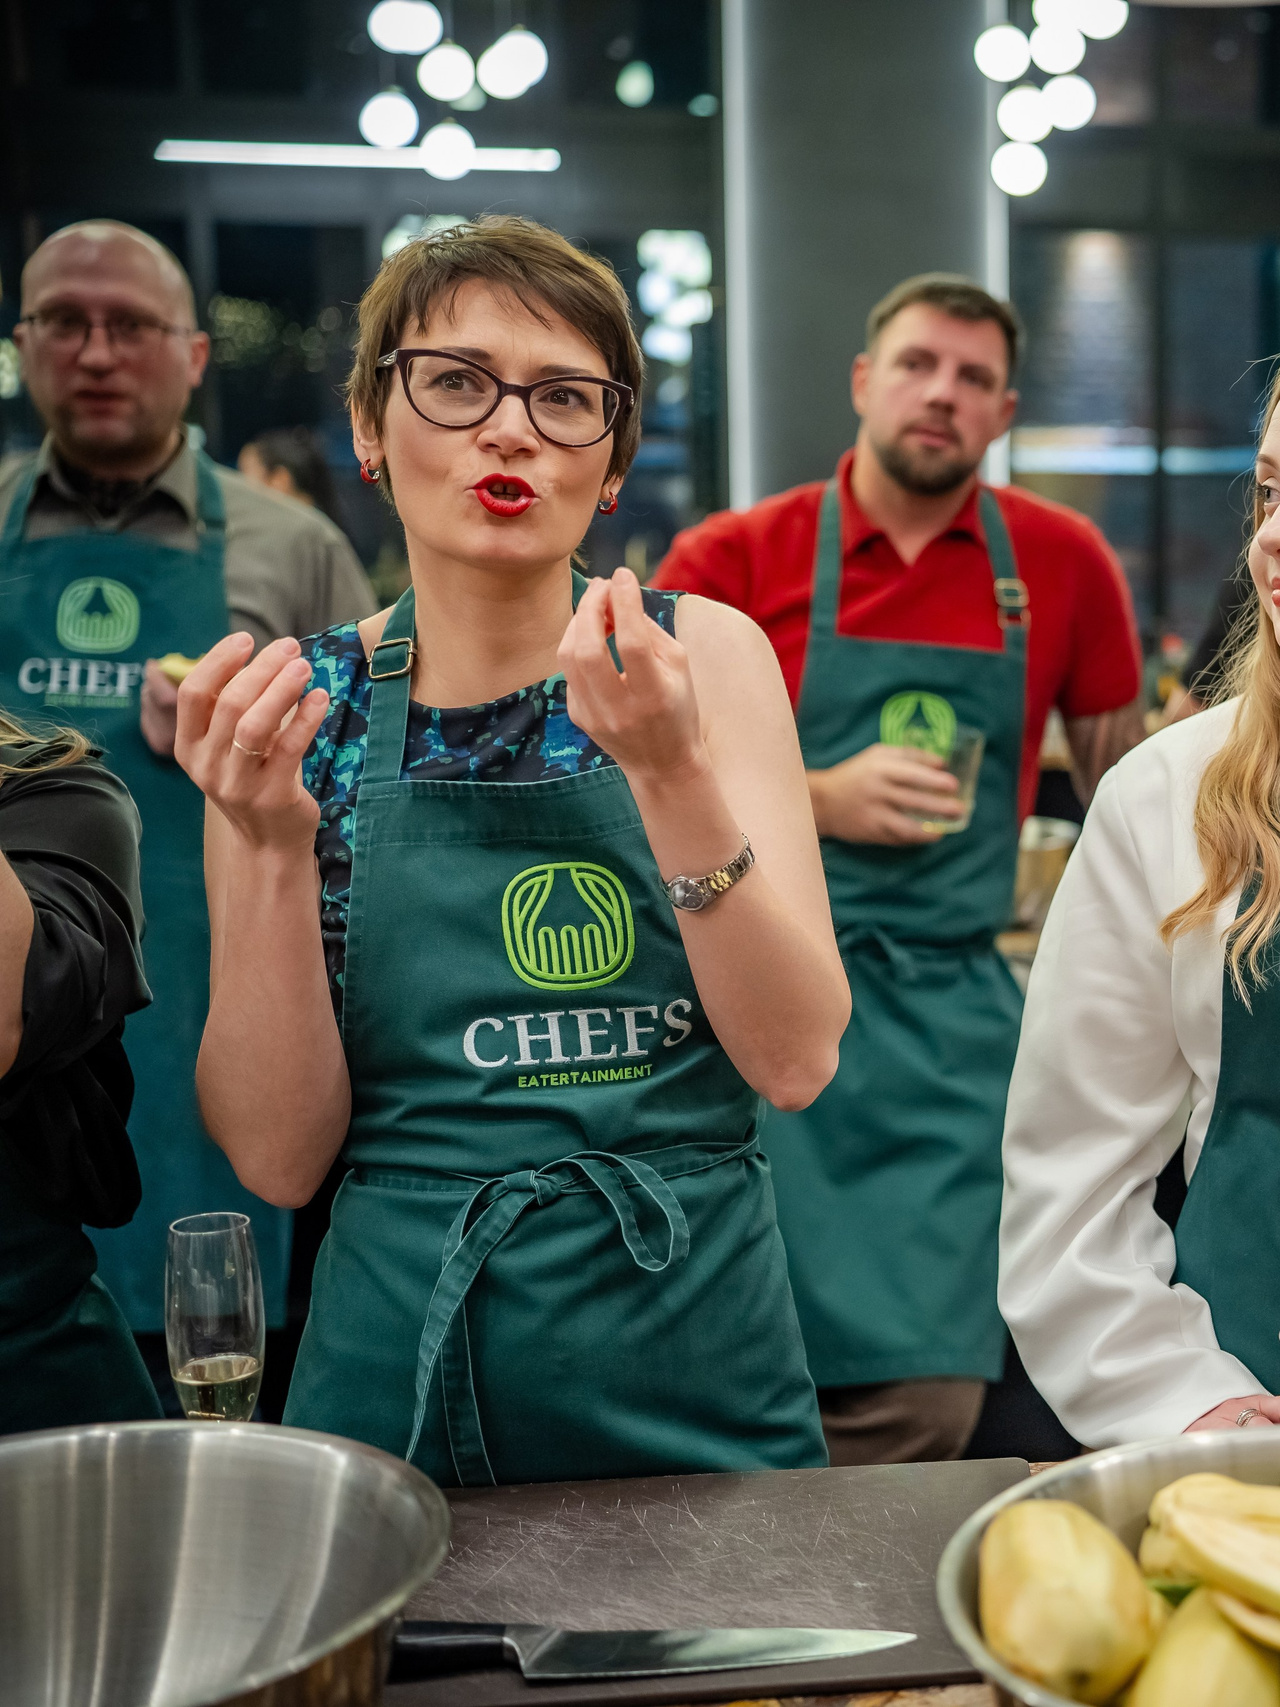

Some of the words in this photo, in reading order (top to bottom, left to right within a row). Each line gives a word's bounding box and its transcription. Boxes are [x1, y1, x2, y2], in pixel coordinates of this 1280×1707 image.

[18, 657, 144, 698] CHEF
[462, 998, 694, 1068] CHEFS
[517, 1063, 653, 1088] EATERTAINMENT
